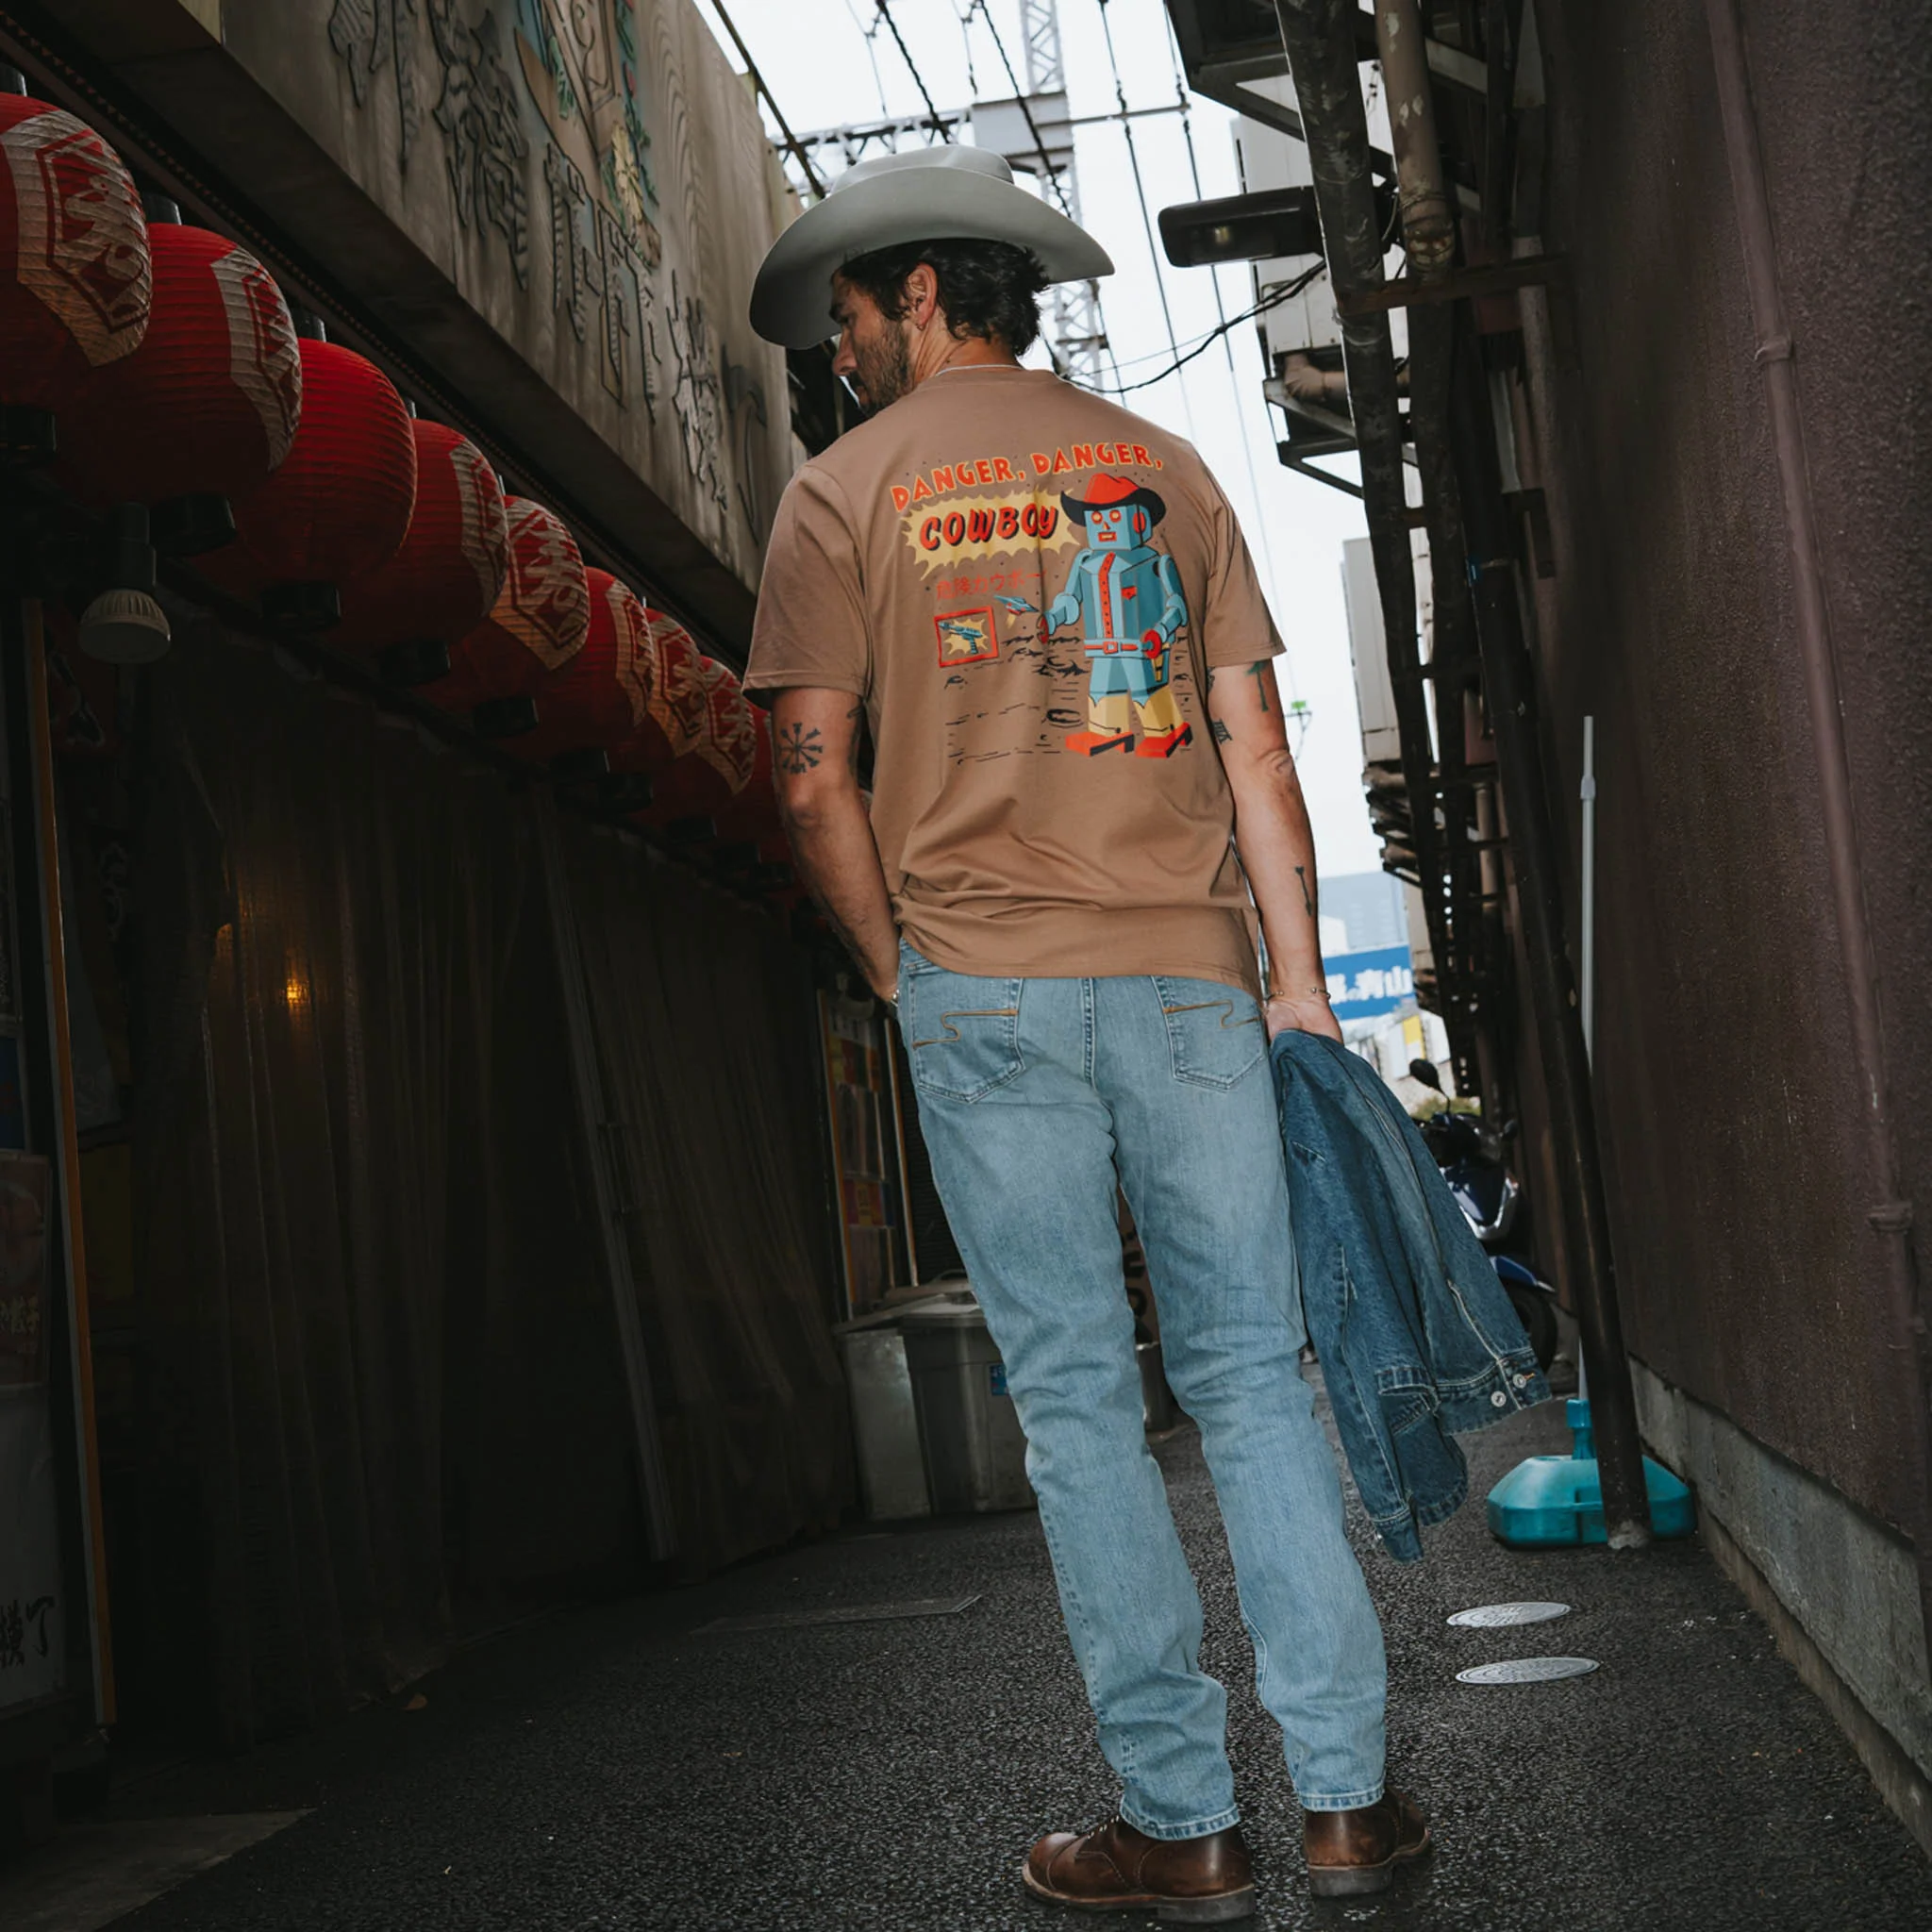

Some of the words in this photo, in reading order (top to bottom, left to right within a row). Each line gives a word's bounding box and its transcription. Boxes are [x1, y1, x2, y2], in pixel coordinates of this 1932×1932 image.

[891, 457, 1025, 511] DANGER,
[1032, 441, 1163, 475] DANGER,
[919, 502, 1058, 551] COWBOY
[936, 568, 1047, 602] 危険カウボー
